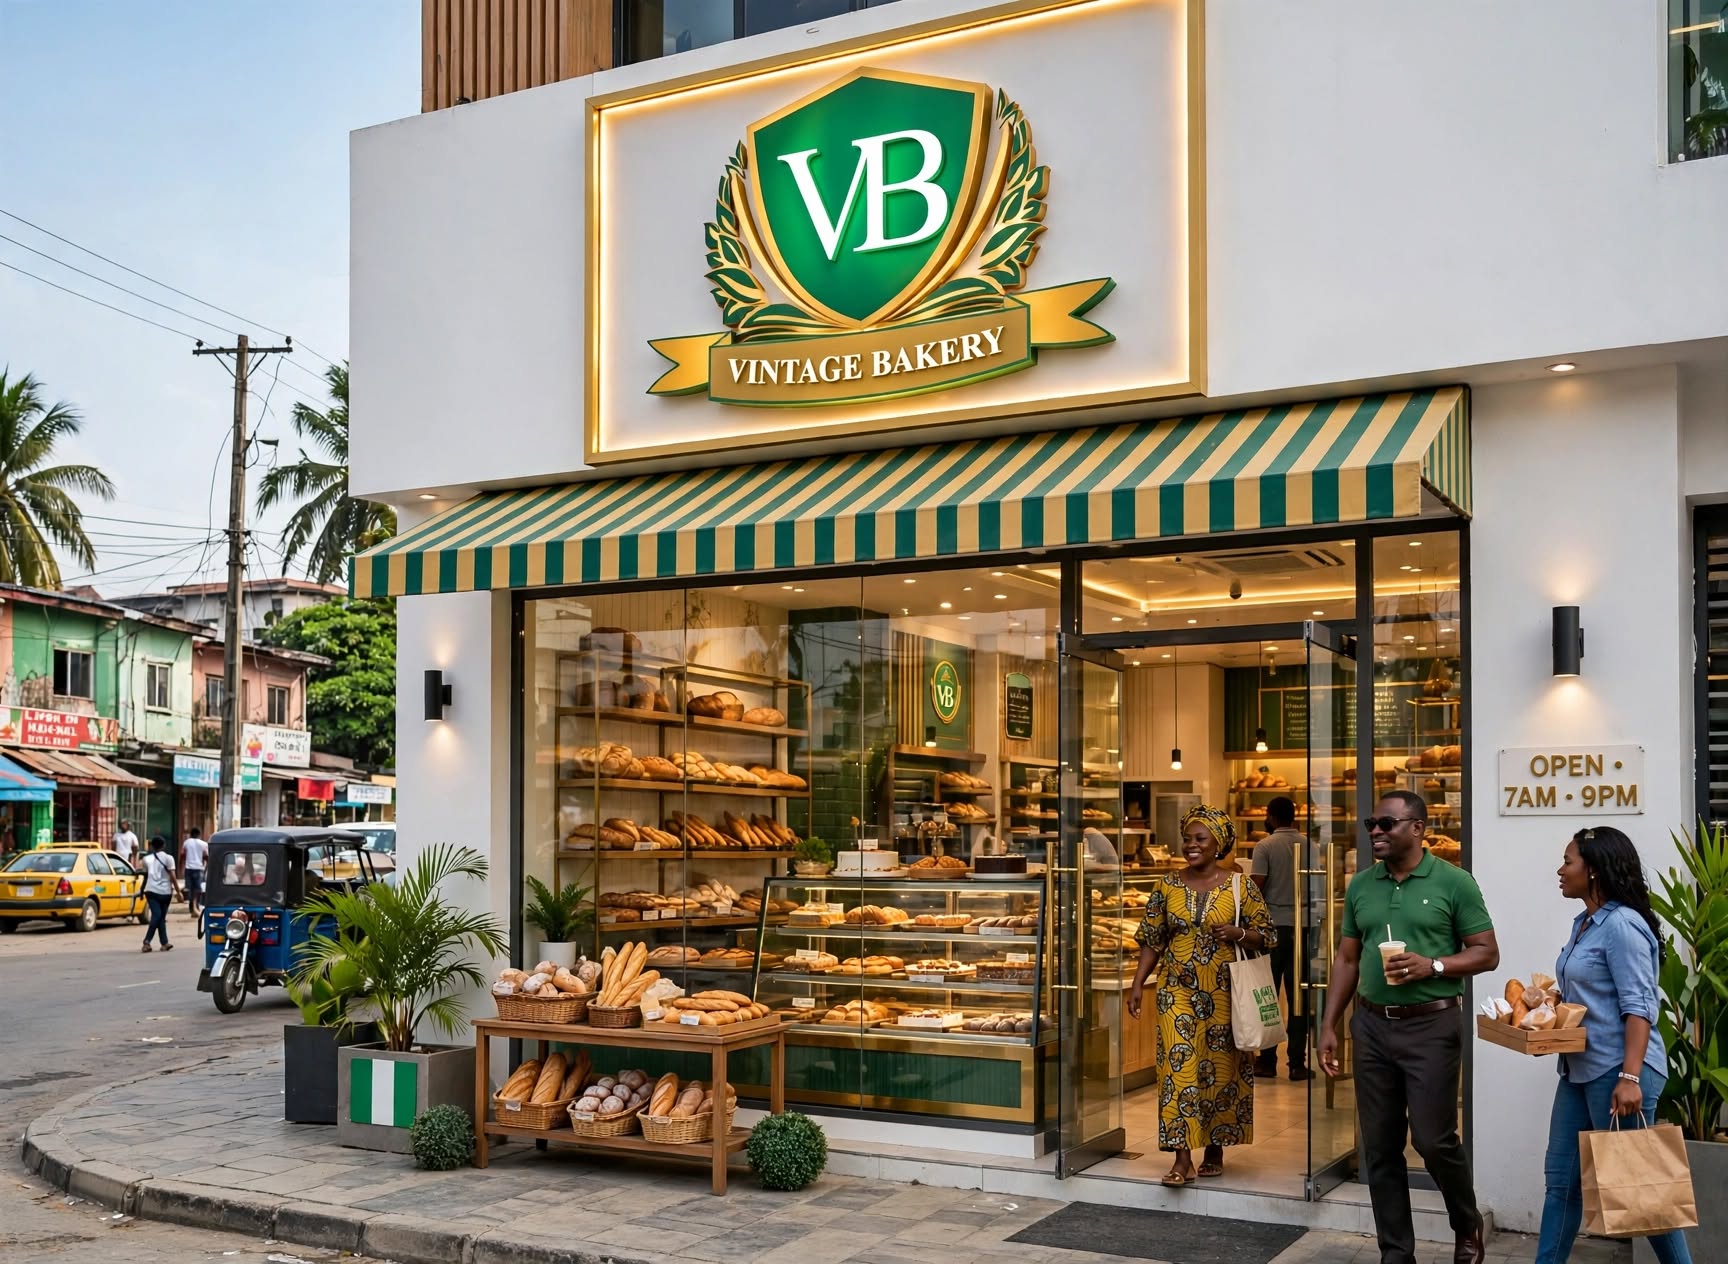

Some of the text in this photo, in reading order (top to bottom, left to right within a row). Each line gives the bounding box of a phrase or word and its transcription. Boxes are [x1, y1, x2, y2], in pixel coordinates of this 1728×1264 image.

[777, 129, 948, 261] VB
[727, 326, 1004, 386] VINTAGE BAKERY
[936, 684, 954, 708] VB
[1530, 754, 1604, 777] OPEN
[1504, 785, 1557, 807] 7AM
[1581, 784, 1638, 807] 9PM
